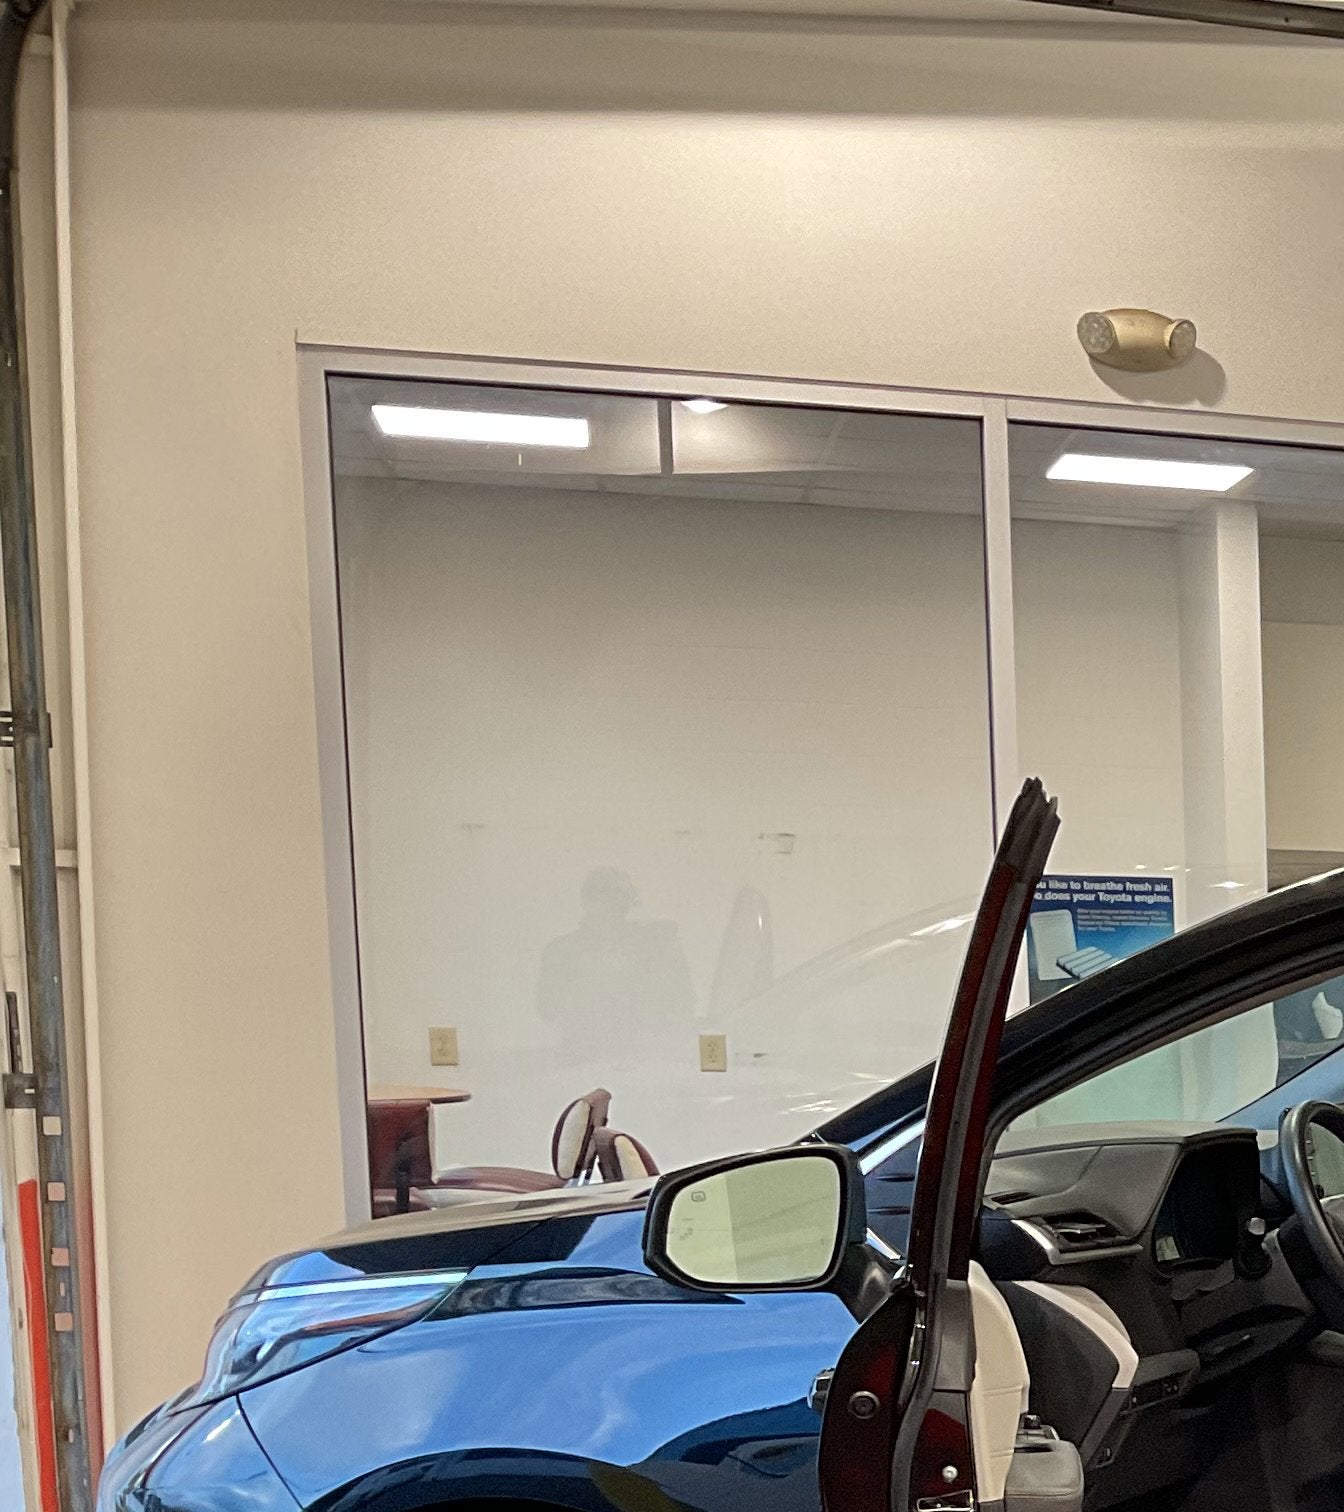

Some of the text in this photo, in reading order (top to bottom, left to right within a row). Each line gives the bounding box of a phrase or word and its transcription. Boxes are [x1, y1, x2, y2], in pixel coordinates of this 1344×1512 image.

[1048, 880, 1068, 889] like
[1070, 881, 1081, 890] to
[1125, 882, 1152, 891] fresh
[1044, 891, 1070, 900] does
[1072, 893, 1095, 903] your
[1097, 892, 1132, 903] Toyota
